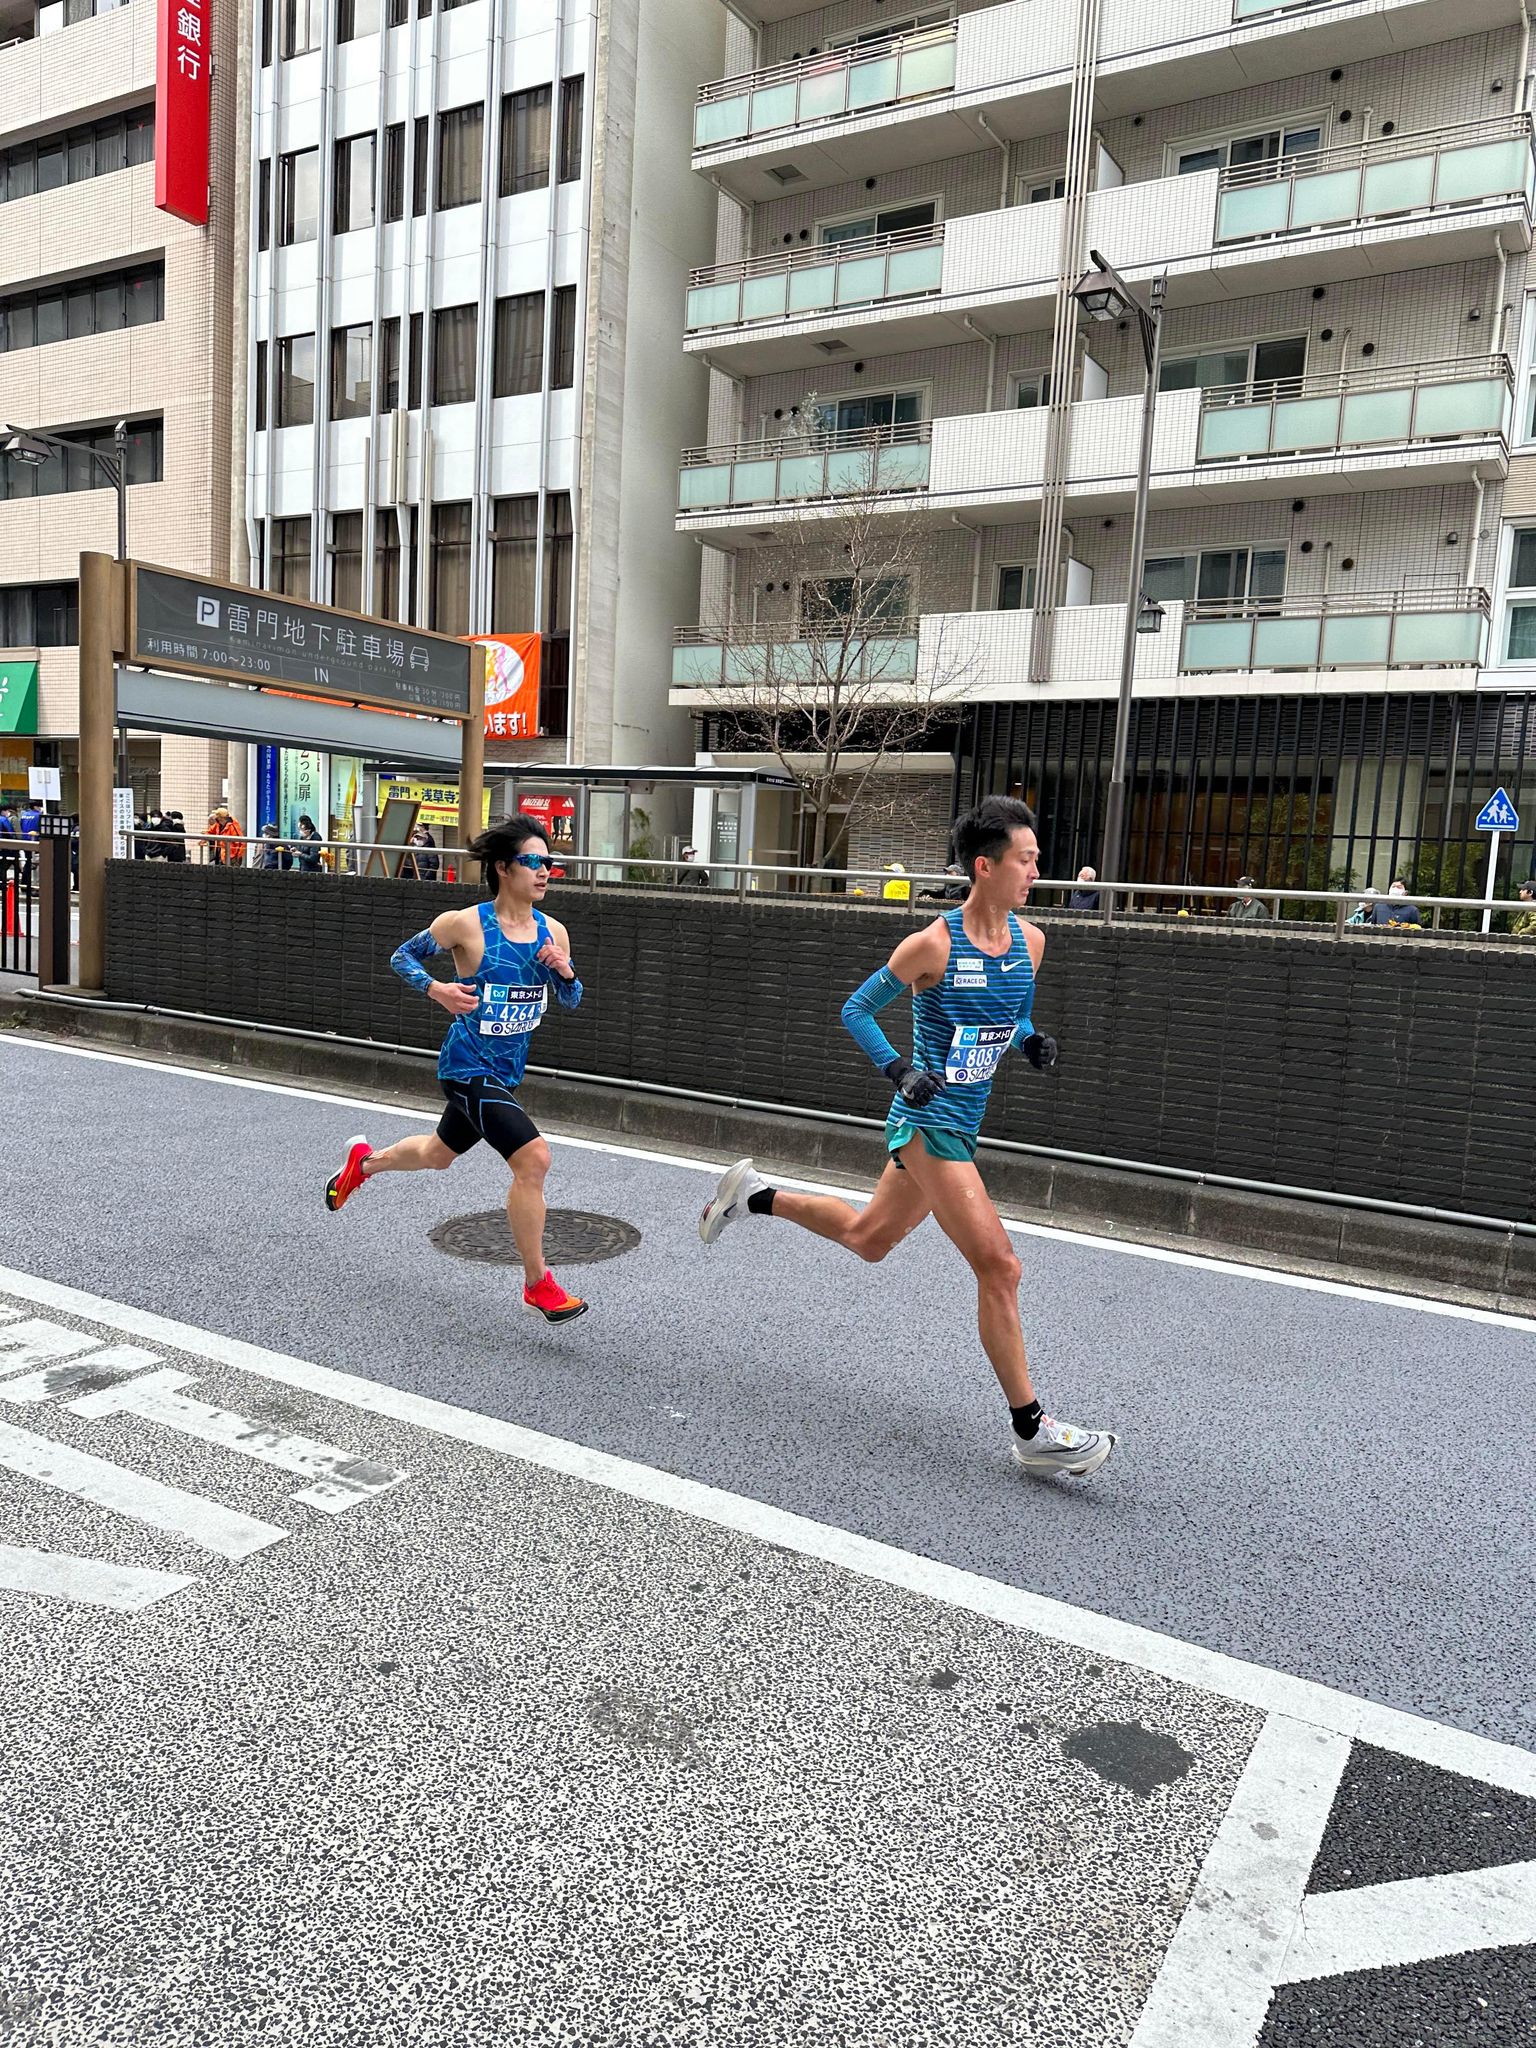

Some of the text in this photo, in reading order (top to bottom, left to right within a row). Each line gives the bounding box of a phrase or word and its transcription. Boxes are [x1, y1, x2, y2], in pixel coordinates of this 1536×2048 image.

[227, 602, 405, 668] 雷門地下駐車場
[147, 637, 198, 660] 利用時間
[301, 650, 364, 670] underground
[367, 663, 402, 677] parking
[313, 666, 329, 684] IN
[485, 1005, 536, 1022] A 4264
[979, 1029, 1011, 1042] 東京メトロ
[951, 1050, 960, 1060] A
